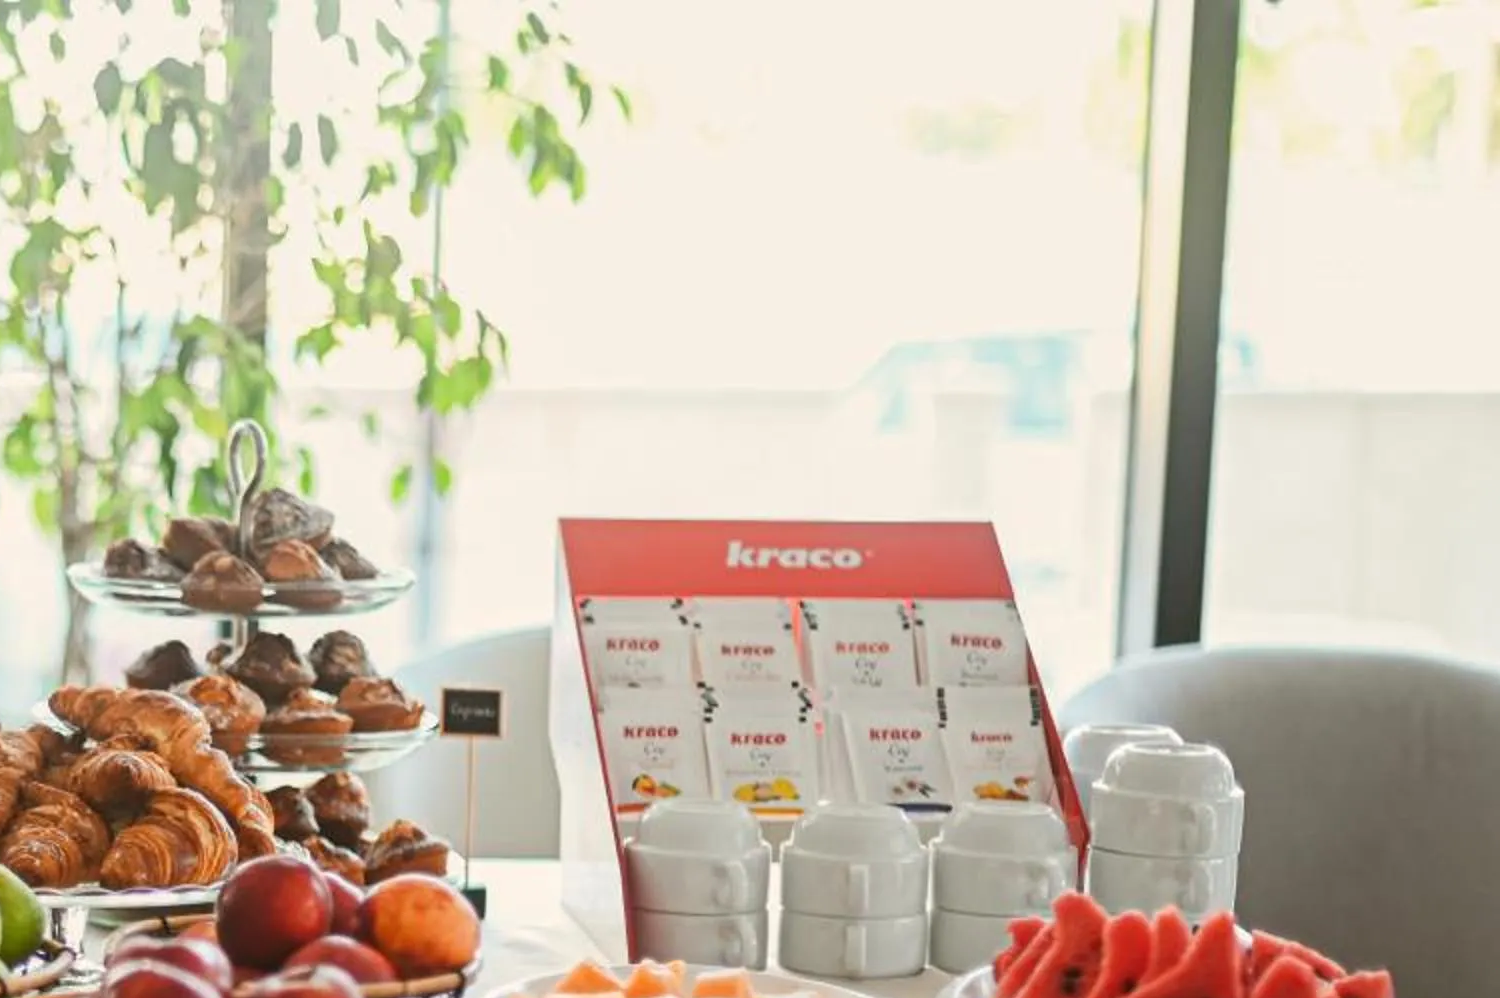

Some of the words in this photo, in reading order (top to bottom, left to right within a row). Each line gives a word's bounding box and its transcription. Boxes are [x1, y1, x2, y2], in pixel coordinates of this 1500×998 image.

[726, 540, 863, 569] kraco
[622, 724, 679, 739] kraco
[868, 727, 922, 742] kraco
[730, 732, 787, 747] kraco
